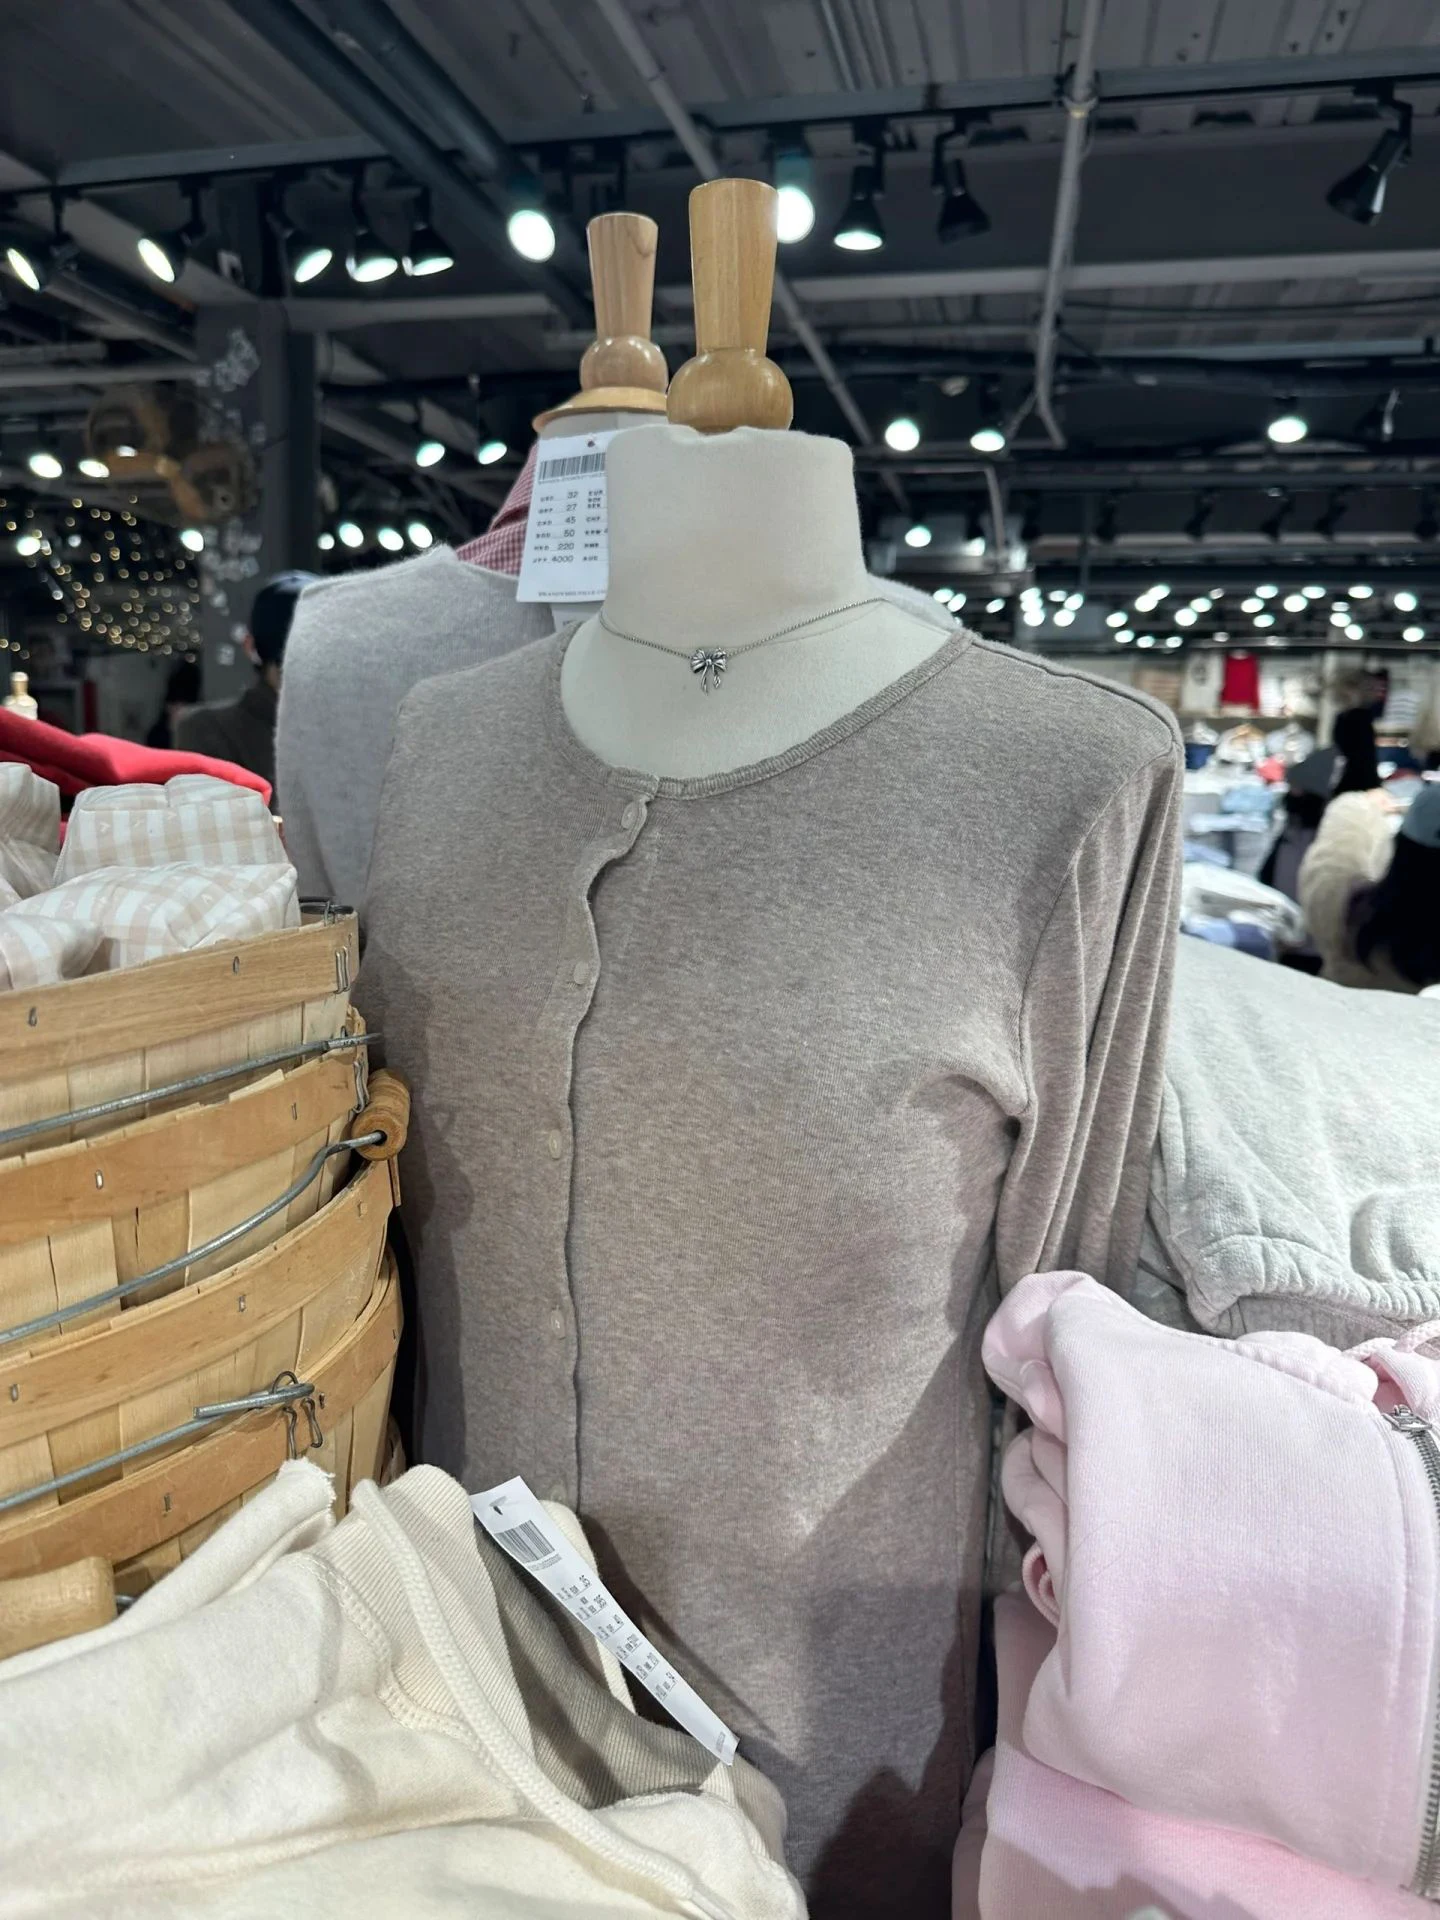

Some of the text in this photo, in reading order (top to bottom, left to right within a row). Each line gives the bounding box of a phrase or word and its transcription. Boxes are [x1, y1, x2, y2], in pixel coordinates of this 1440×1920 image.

[567, 491, 578, 499] 32
[566, 504, 577, 512] 27
[565, 516, 576, 524] 45
[564, 529, 575, 537] 50
